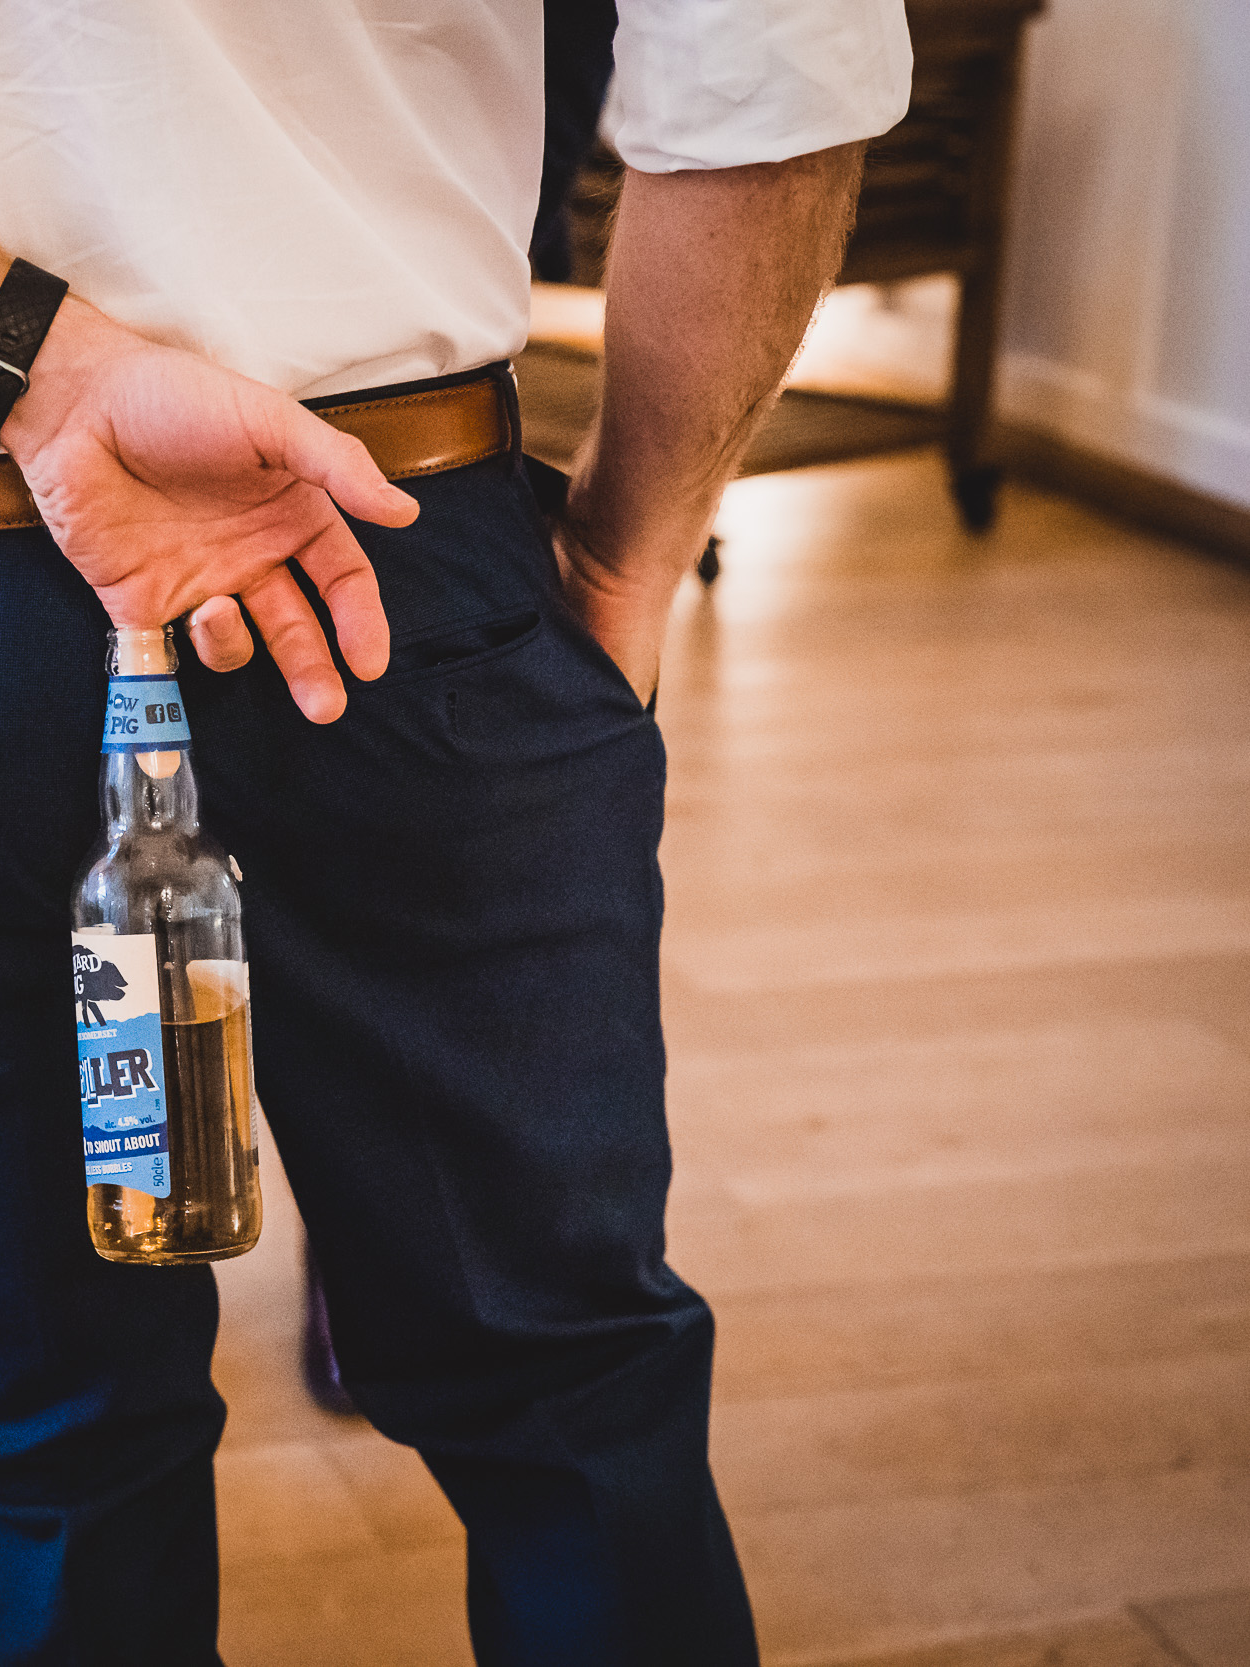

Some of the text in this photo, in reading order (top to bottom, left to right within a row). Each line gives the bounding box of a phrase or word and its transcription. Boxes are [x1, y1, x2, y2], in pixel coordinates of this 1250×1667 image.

[110, 716, 139, 734] PIG
[140, 1114, 155, 1124] vol.
[94, 1138, 121, 1154] SHOUT
[124, 1132, 160, 1151] ABOUT
